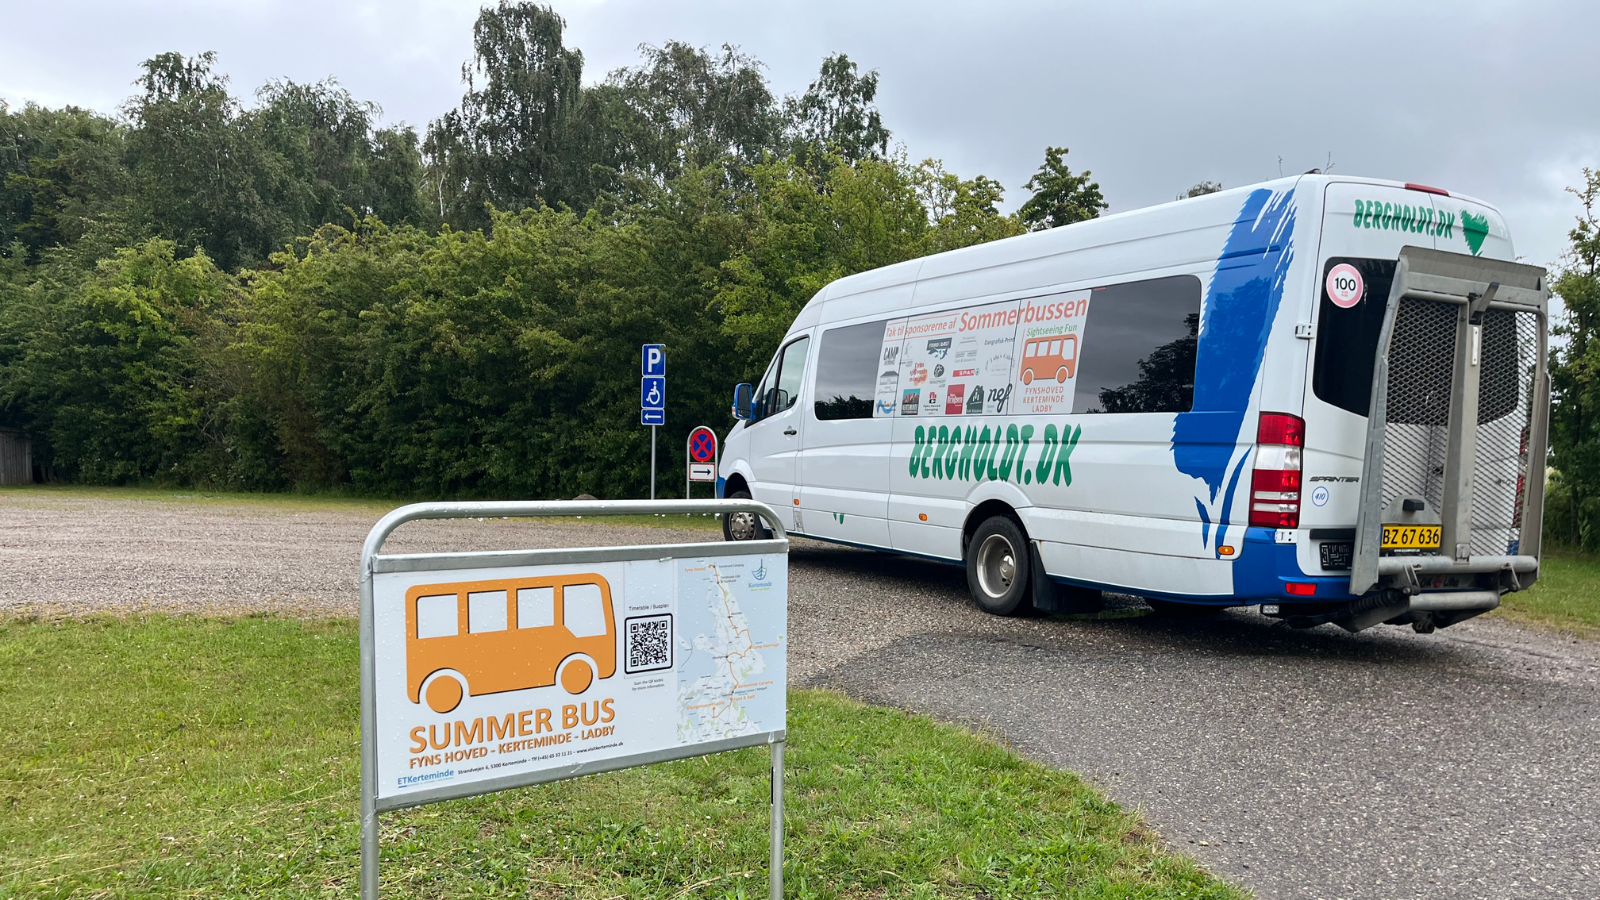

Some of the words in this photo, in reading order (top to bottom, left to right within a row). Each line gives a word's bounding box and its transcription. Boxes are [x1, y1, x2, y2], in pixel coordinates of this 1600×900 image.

[1353, 199, 1455, 239] BERGHOLDT.DK
[1335, 278, 1357, 292] 100
[886, 327, 896, 337] Tak
[897, 325, 905, 336] til
[948, 317, 958, 329] af
[958, 299, 1087, 332] Sommerbussen
[1026, 326, 1063, 338] Sightseeing
[1064, 323, 1077, 332] Fun
[648, 348, 661, 373] P
[883, 346, 899, 361] CAMP
[1025, 386, 1064, 394] FYNSHOVED
[1022, 395, 1064, 404] KERTEMINDE
[909, 423, 1082, 487] BERGHOLDT.DK
[1315, 492, 1326, 500] 410
[1383, 530, 1399, 544] BZ
[1401, 529, 1417, 544] 67
[1418, 528, 1440, 544] 636
[409, 708, 553, 754] SUMMER
[562, 698, 615, 730] BUS
[409, 755, 442, 769] FYNS
[445, 746, 488, 763] HOVED
[498, 731, 571, 754] KERTEMINDE
[582, 725, 615, 740] LADBY
[458, 766, 485, 775] Strandvejen
[502, 758, 527, 767] Kerteminde
[397, 768, 454, 786] ETKerteminde
